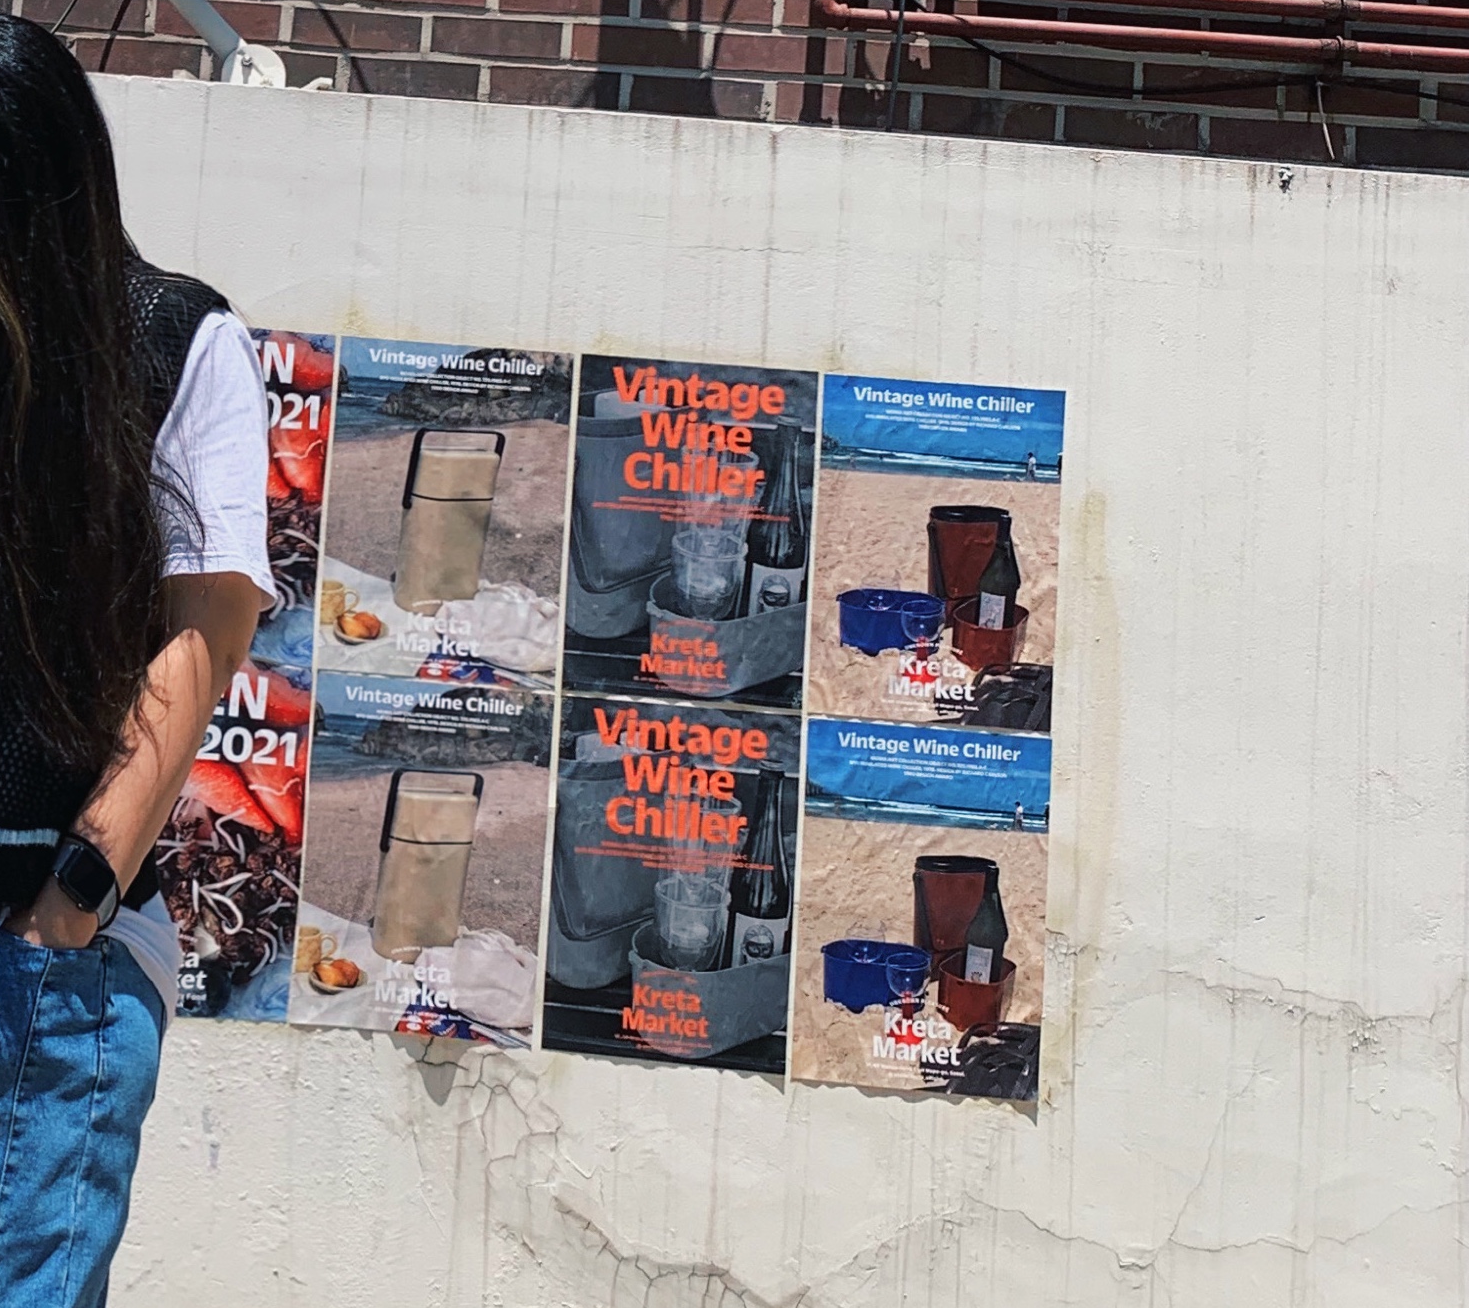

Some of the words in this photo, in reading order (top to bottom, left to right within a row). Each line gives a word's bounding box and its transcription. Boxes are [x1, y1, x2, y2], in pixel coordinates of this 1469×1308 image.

[369, 348, 438, 368] Vintage
[441, 354, 485, 372] Wine
[488, 358, 545, 376] Chiller
[268, 392, 320, 430] 21
[612, 366, 786, 425] Vintage
[853, 386, 924, 407] Vintage
[928, 392, 973, 409] Wine
[976, 396, 1035, 414] Chiller
[641, 411, 752, 455] Wine
[623, 452, 765, 497] Chiller
[407, 612, 472, 636] Kreta
[396, 632, 480, 658] Market
[652, 632, 718, 657] Kreta
[640, 653, 727, 679] Market
[899, 655, 966, 679] Kreta
[345, 685, 415, 707] Vintage
[418, 692, 463, 711] Wine
[465, 696, 524, 716] Chiller
[888, 674, 976, 702] Market
[195, 724, 297, 767] 2021
[593, 707, 768, 769] Vintage
[838, 731, 909, 754] Vintage
[913, 738, 960, 757] Wine
[963, 743, 1021, 762] Chiller
[622, 755, 735, 801] Wine
[605, 796, 748, 846] Chiller
[385, 959, 451, 984] Kreta
[374, 980, 458, 1010] Market
[633, 982, 701, 1013] Kreta
[622, 1007, 709, 1038] Market
[884, 1012, 951, 1040] Kreta
[873, 1035, 962, 1066] Market
